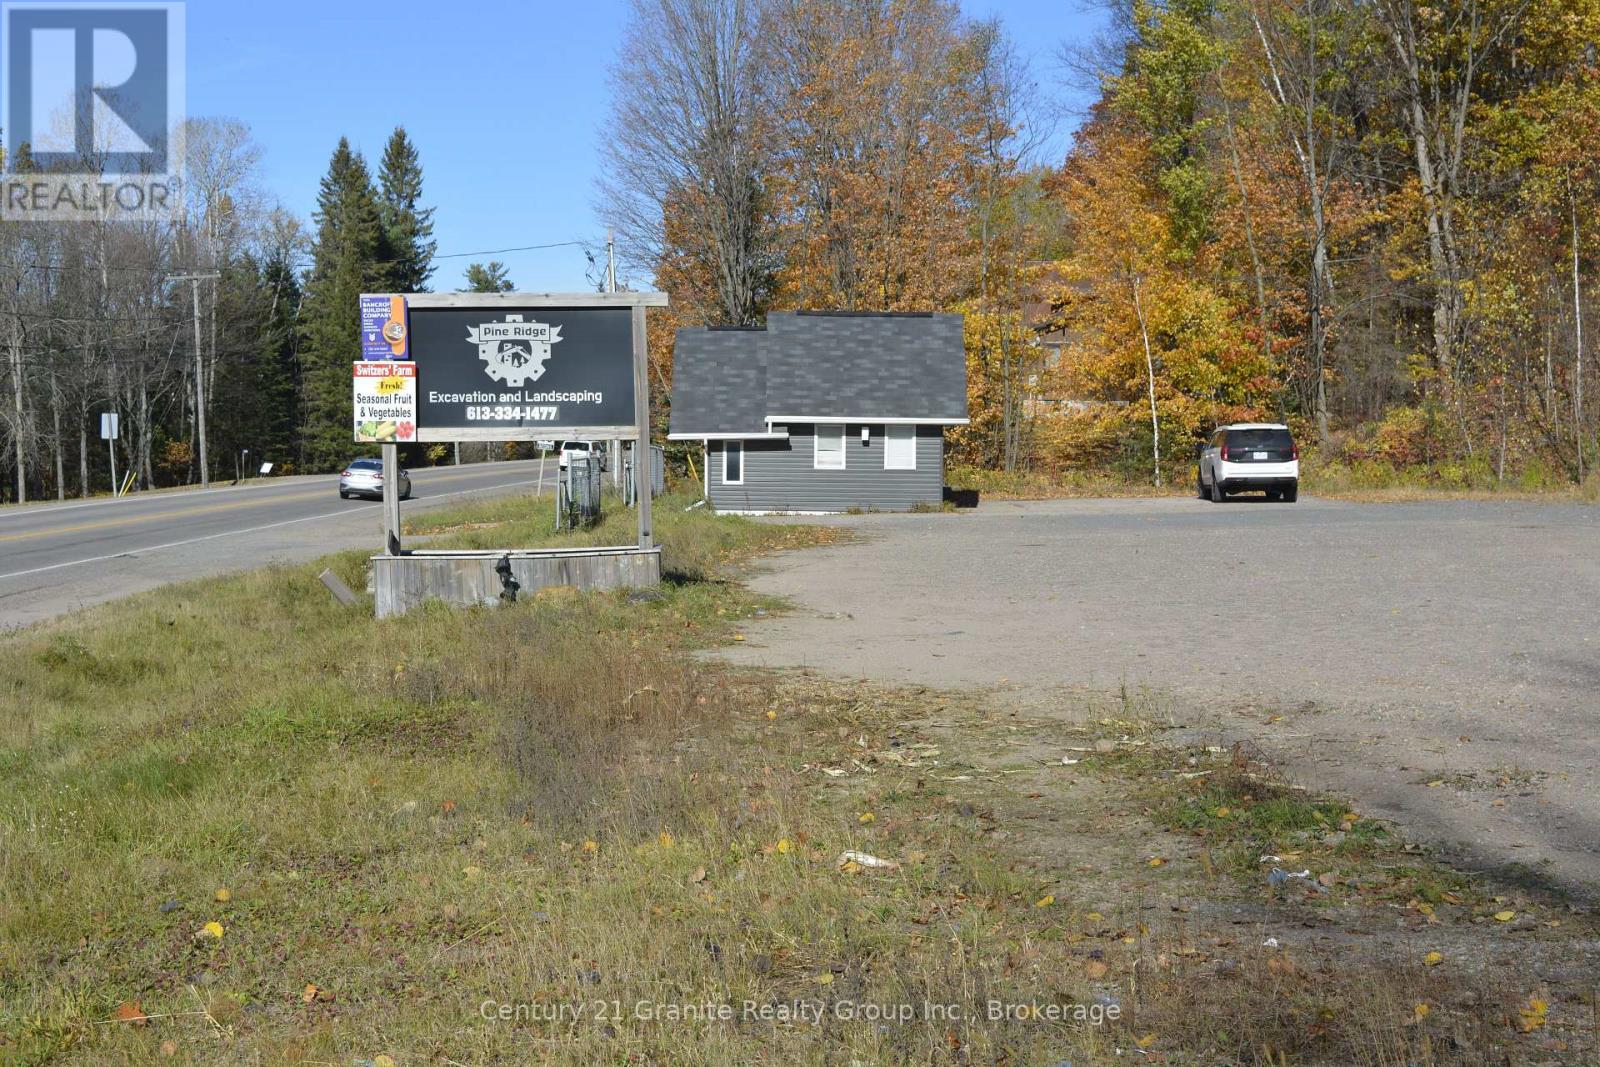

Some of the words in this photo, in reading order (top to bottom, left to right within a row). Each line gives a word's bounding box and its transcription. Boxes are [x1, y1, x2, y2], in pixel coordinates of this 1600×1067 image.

[484, 326, 509, 336] Pine
[514, 326, 547, 337] Ridge
[356, 365, 391, 376] Switzers'
[393, 365, 413, 376] Farm
[380, 381, 403, 390] Fresh!
[356, 393, 392, 404] Seasonal
[394, 393, 412, 404] Fruit
[429, 391, 496, 403] Excavation
[499, 390, 522, 402] and
[525, 390, 603, 405] Landscaping
[360, 407, 366, 418] &
[368, 407, 412, 420] Vegetables
[466, 406, 558, 421] 613-334-1477
